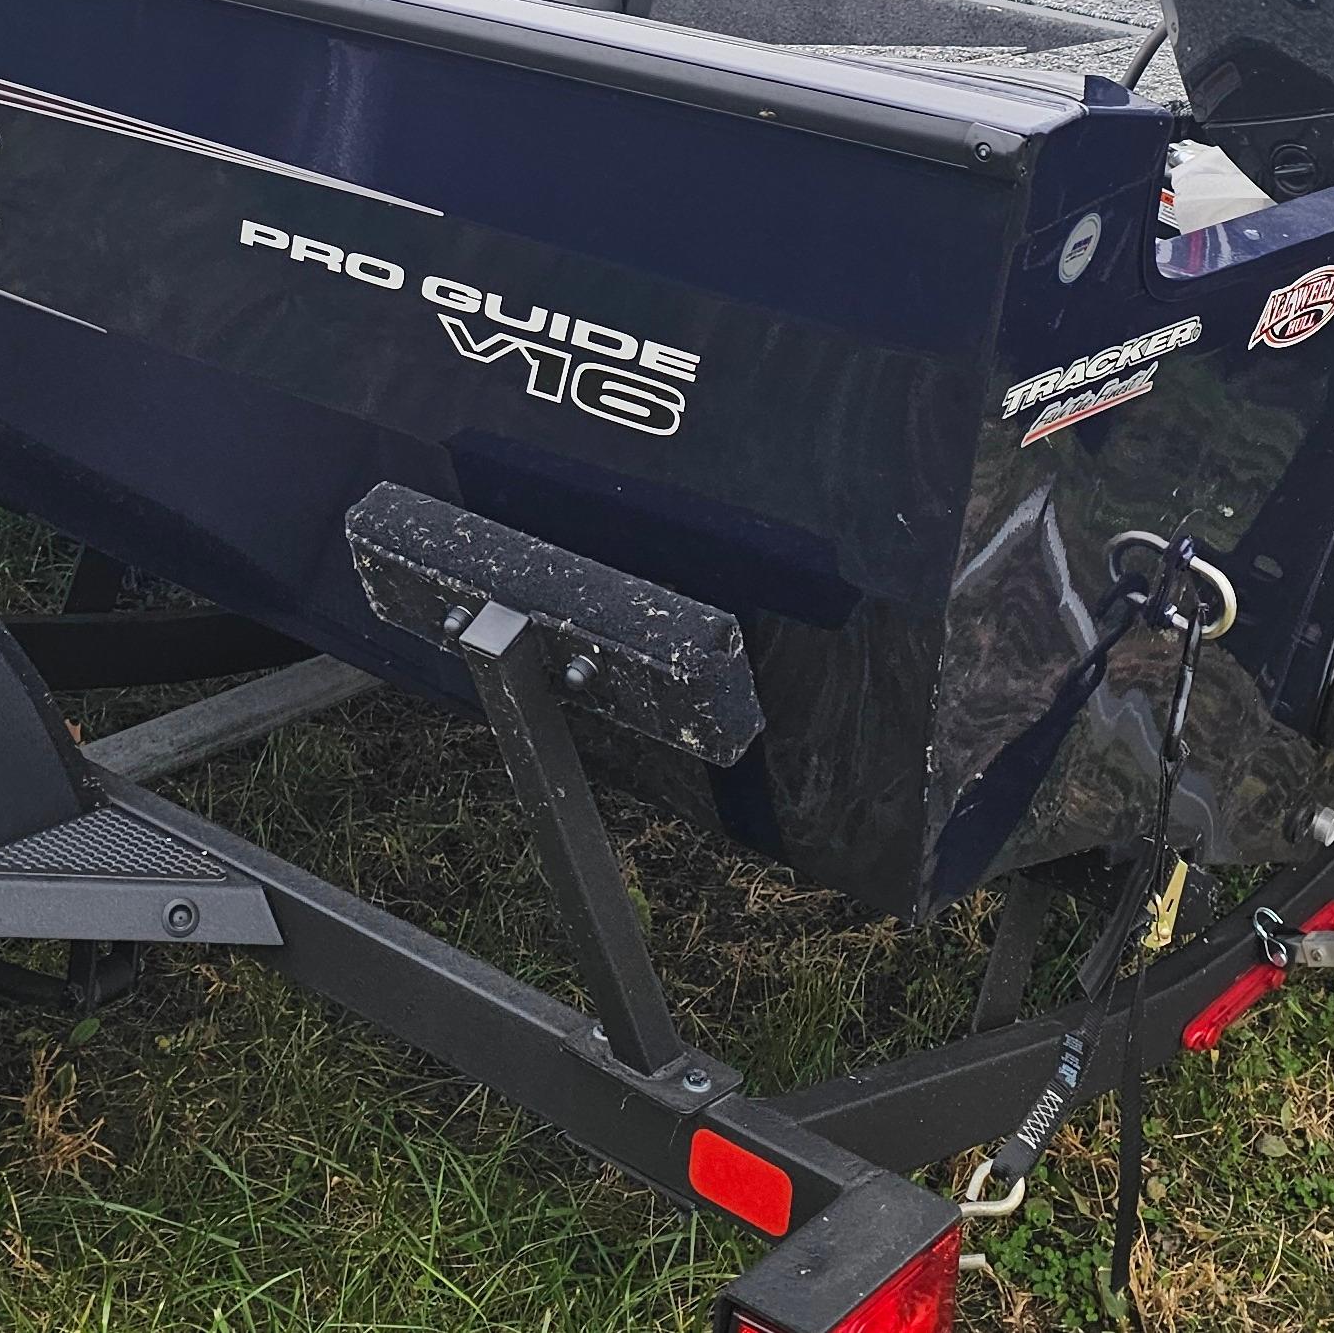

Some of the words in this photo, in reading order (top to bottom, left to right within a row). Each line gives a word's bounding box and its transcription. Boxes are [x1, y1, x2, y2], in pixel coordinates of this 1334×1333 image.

[240, 219, 405, 290] PRO
[421, 275, 701, 383] GUIDE
[1284, 312, 1317, 337] HULL
[437, 313, 686, 436] V16
[1002, 317, 1198, 419] TRACKER
